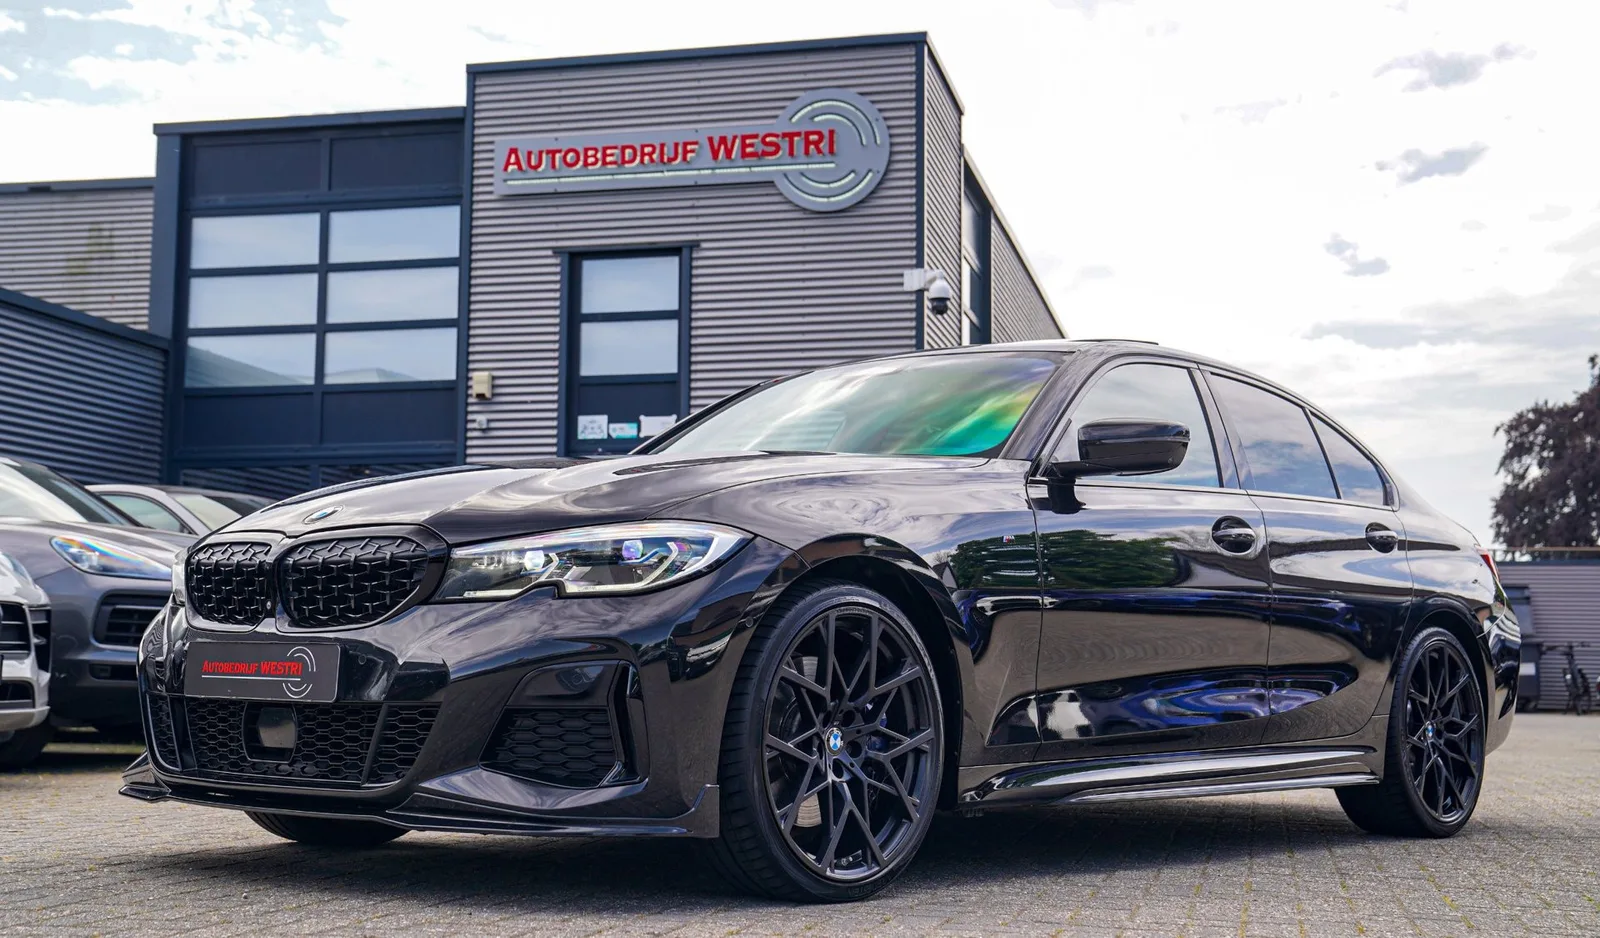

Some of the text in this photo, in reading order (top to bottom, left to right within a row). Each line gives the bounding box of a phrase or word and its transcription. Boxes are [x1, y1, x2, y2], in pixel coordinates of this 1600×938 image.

[503, 129, 837, 173] AUTOBEDRIJF WESTRI
[202, 660, 303, 676] AUTOBEDRIJF WESTRI
